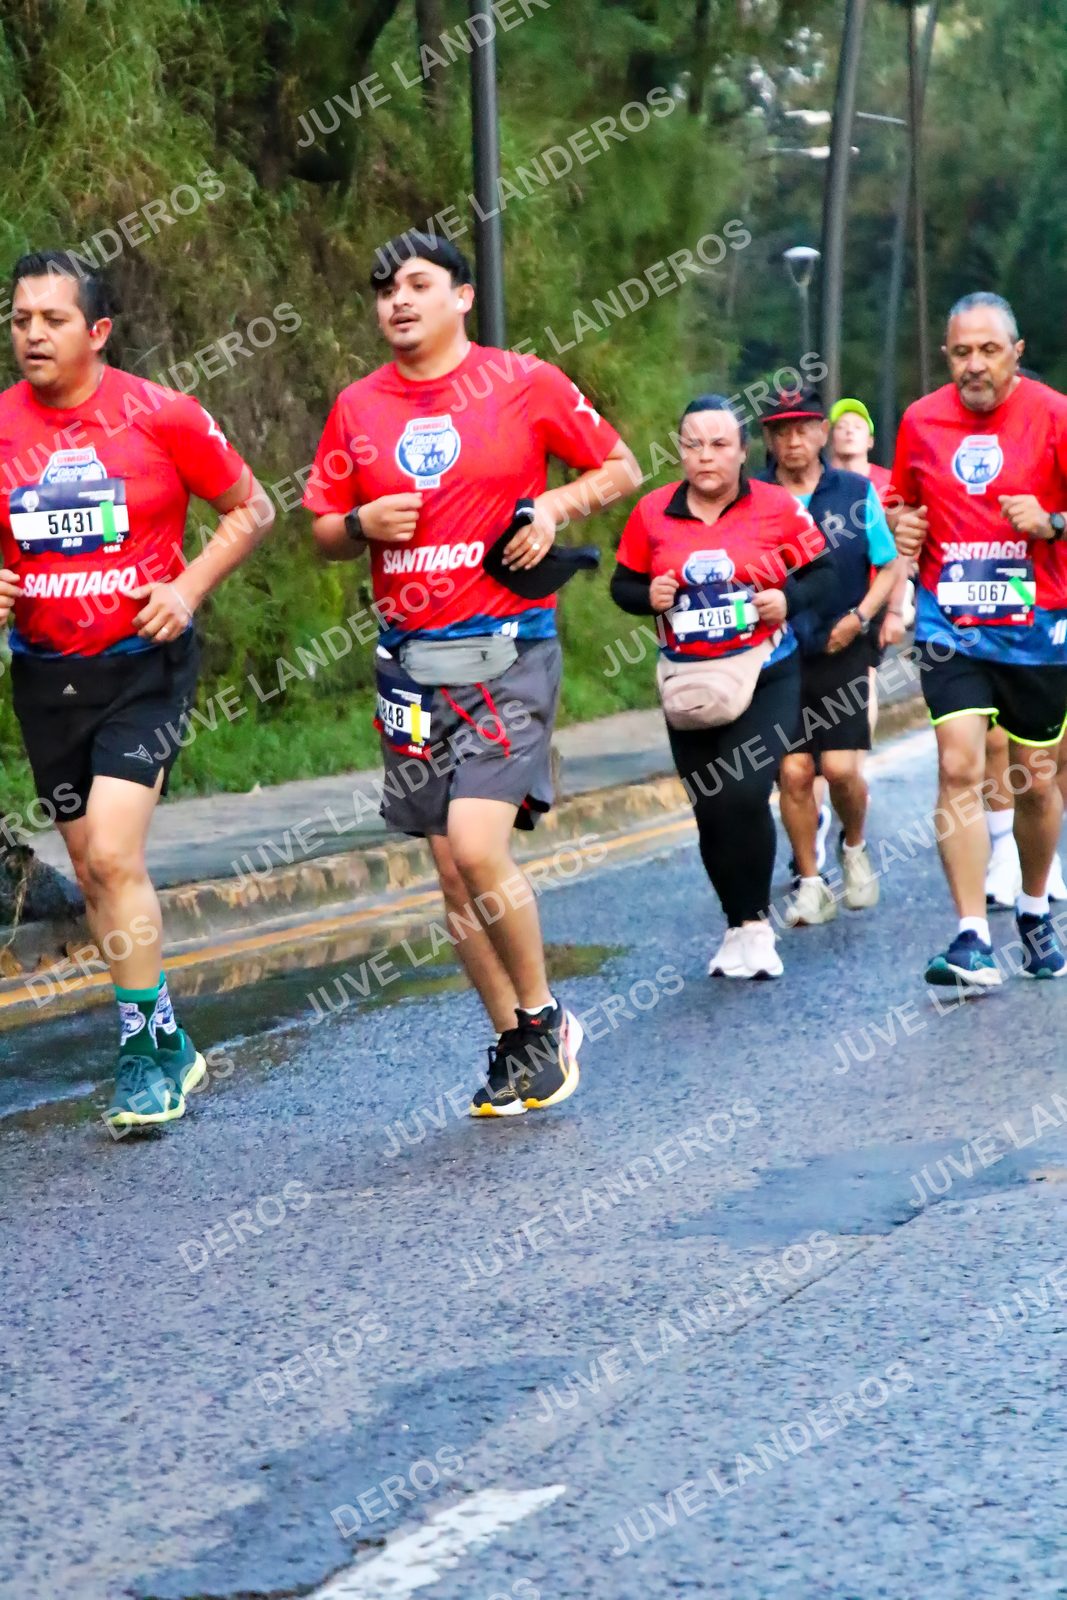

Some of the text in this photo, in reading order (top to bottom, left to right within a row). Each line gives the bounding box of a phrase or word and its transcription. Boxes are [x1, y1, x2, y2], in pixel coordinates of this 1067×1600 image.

[48, 511, 94, 535] 5431
[383, 541, 485, 574] SANTIAGO
[24, 567, 137, 598] SANTIAGO
[967, 584, 1008, 602] 5067
[698, 609, 732, 627] 4216
